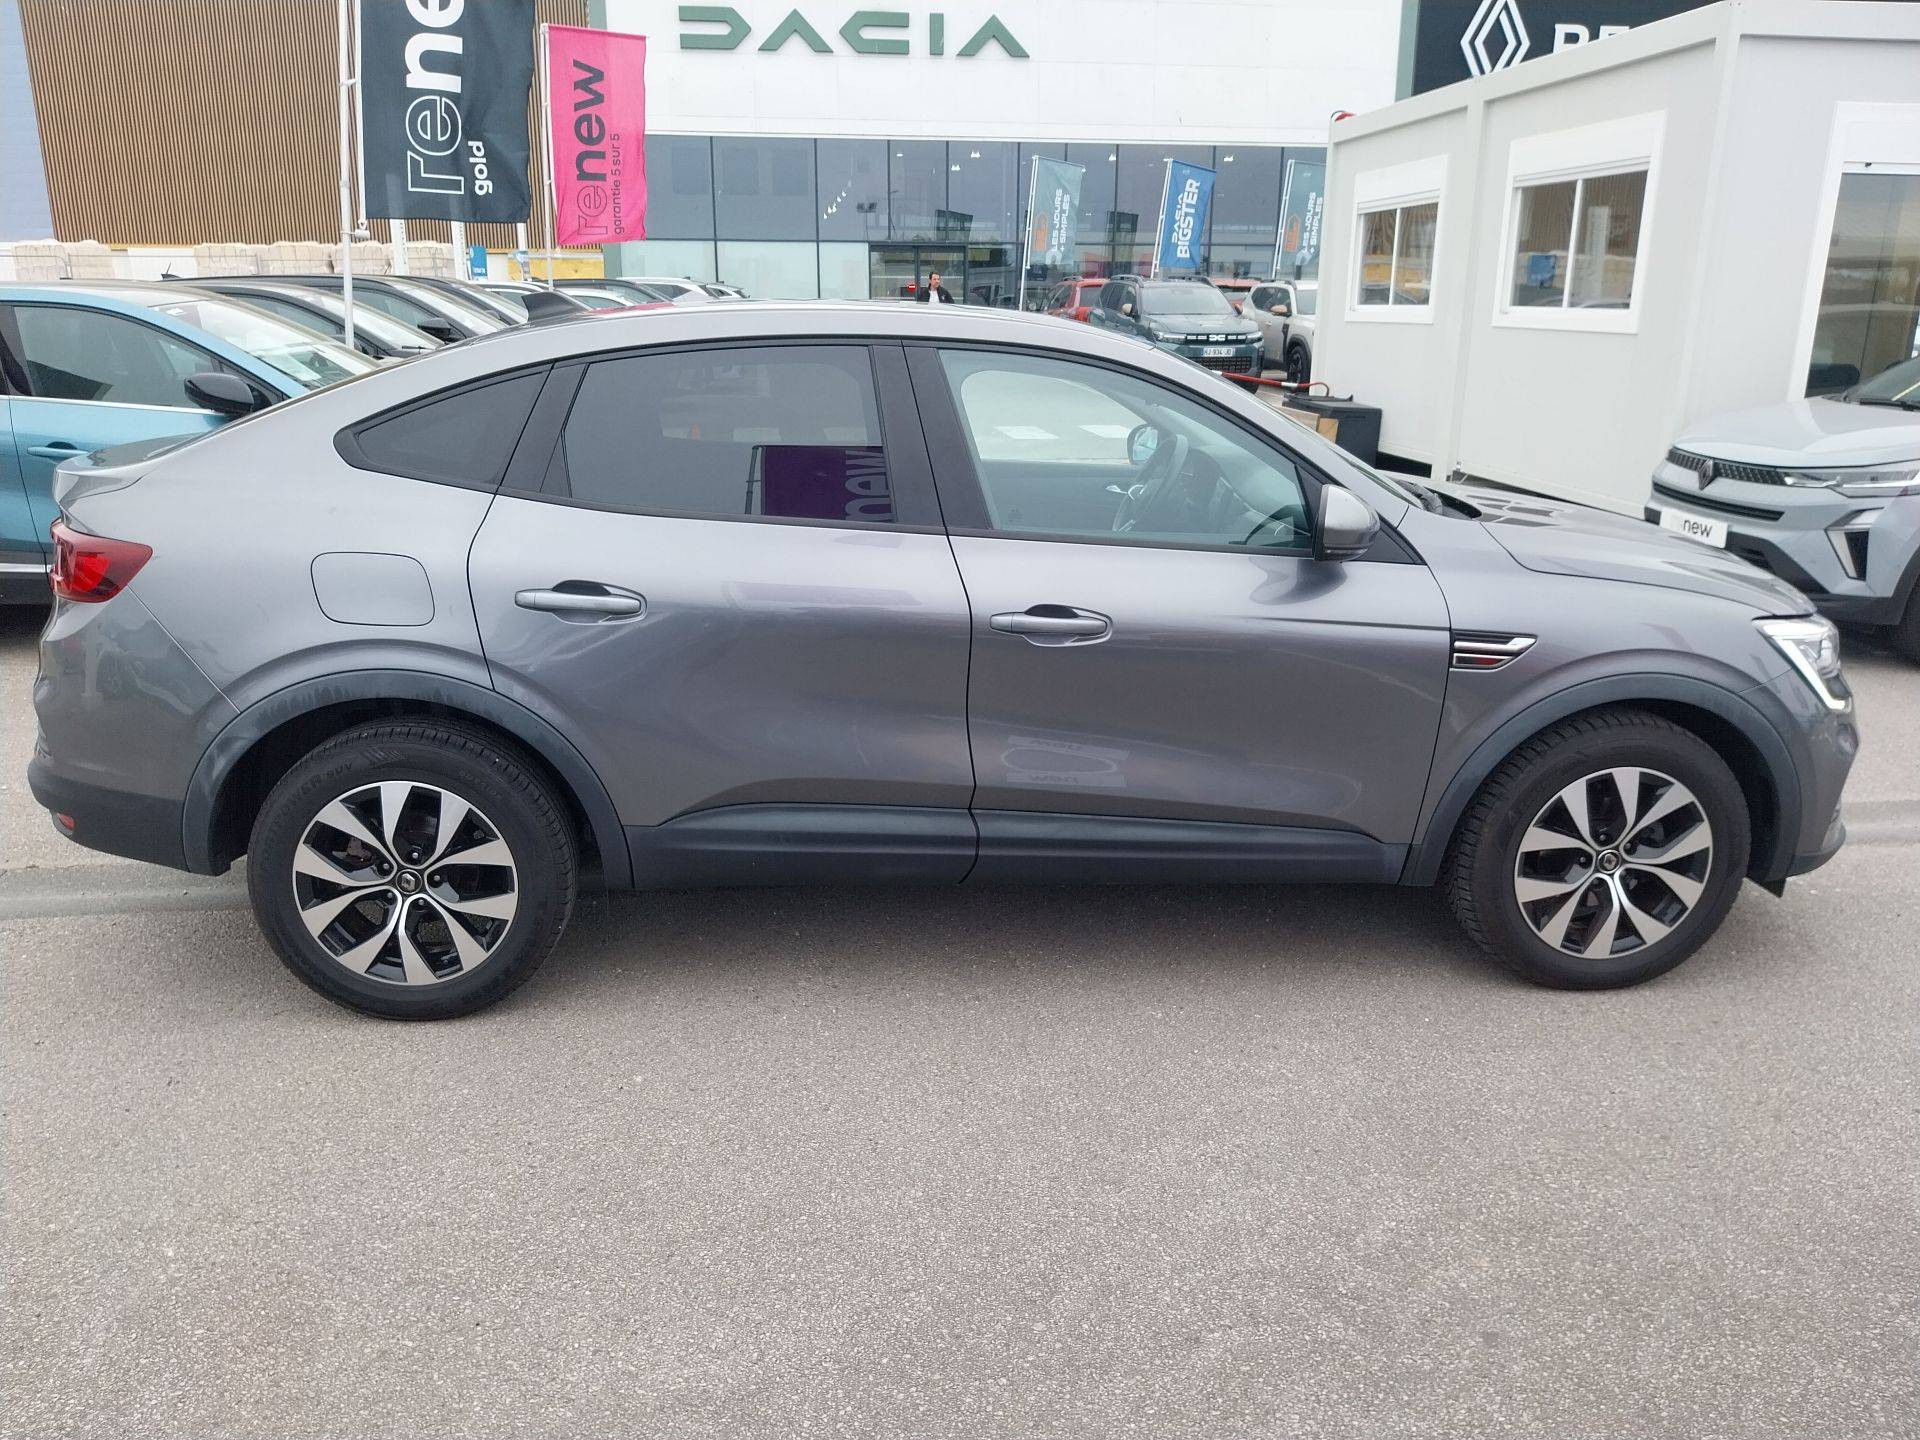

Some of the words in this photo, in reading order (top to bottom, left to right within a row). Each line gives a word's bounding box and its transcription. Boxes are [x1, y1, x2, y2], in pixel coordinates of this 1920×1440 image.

[678, 5, 1030, 58] DACIA
[468, 141, 493, 195] gold
[573, 58, 607, 235] renew
[612, 144, 620, 166] sur
[611, 178, 624, 235] garantie
[1053, 188, 1063, 228] JOURS
[1060, 193, 1070, 243] SIMPLES
[1177, 178, 1200, 258] BIGSTER
[1304, 192, 1316, 231] JOURS
[1310, 196, 1322, 246] SIMPLES
